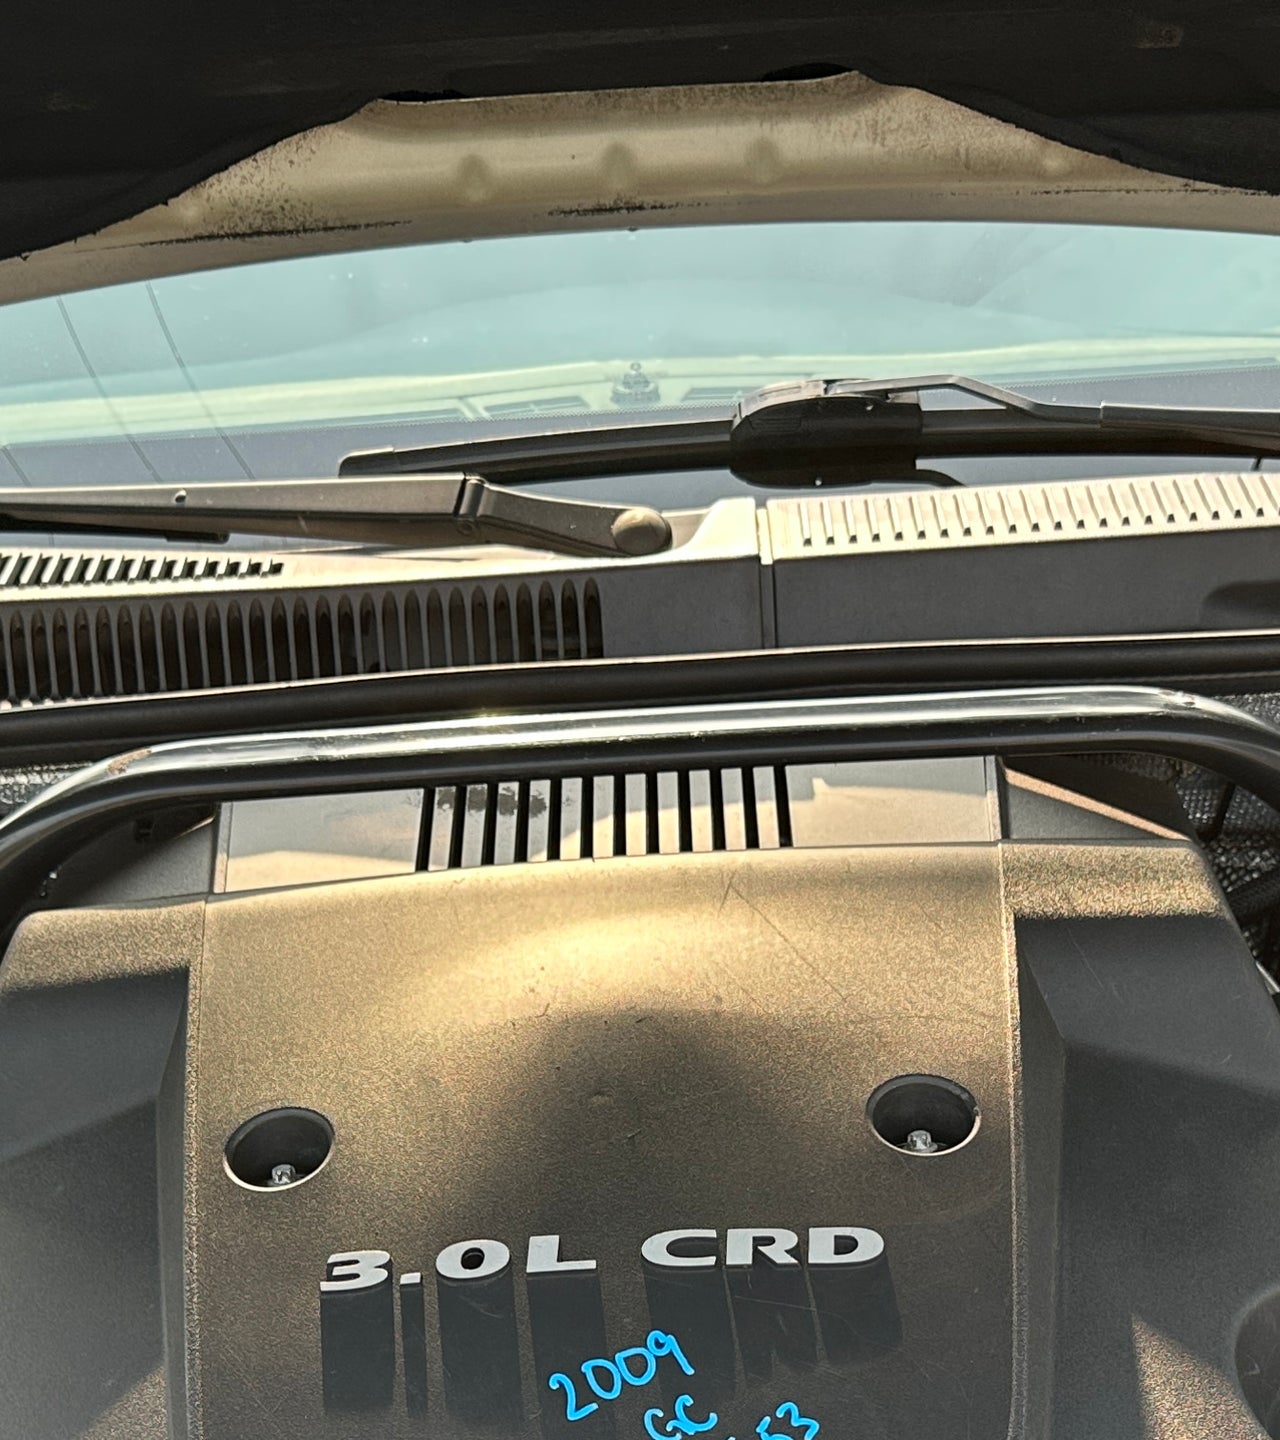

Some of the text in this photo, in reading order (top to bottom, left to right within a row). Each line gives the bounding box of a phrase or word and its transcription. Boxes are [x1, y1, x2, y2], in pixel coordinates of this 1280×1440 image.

[320, 1226, 884, 1292] 3.0L CRD
[548, 1329, 695, 1422] 2009
